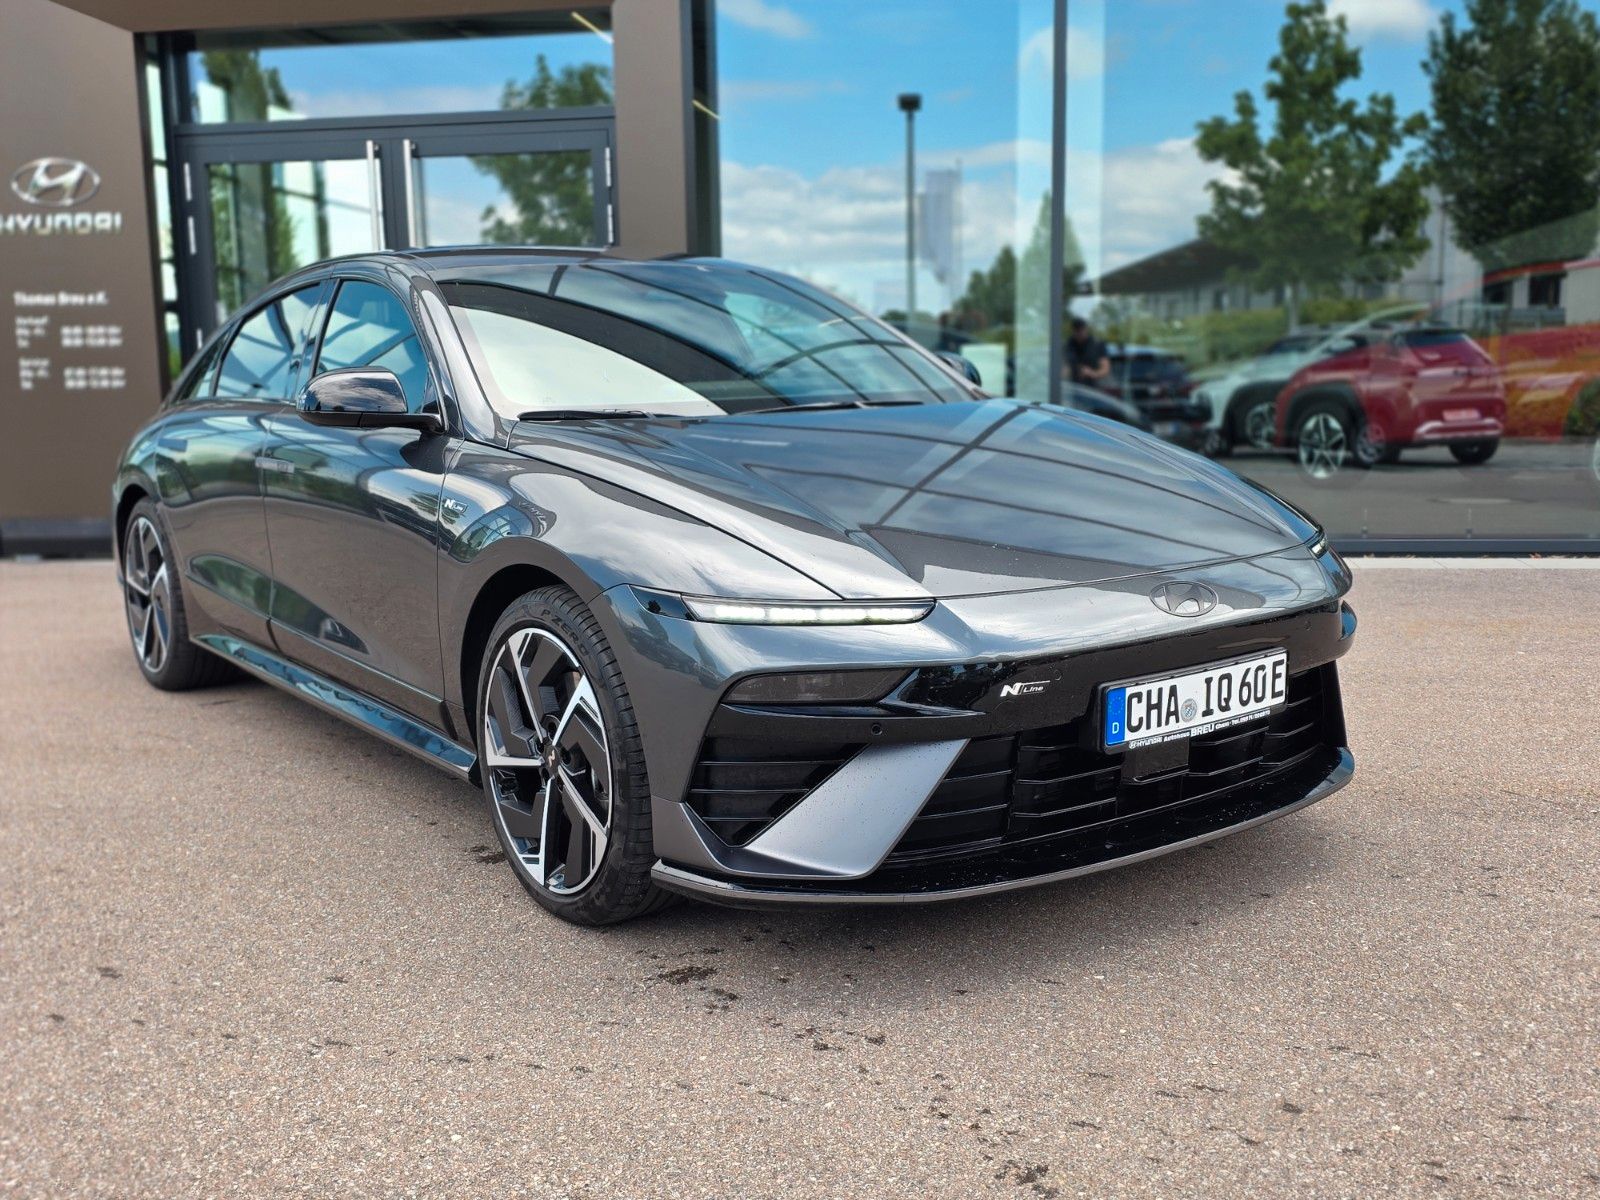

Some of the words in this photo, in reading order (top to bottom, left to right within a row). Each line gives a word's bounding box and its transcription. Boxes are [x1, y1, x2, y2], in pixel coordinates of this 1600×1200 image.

[0, 211, 122, 235] HYUNDAI
[1112, 722, 1120, 734] D
[1126, 684, 1180, 733] CHA
[1202, 672, 1233, 717] IQ
[1190, 723, 1215, 738] BREU
